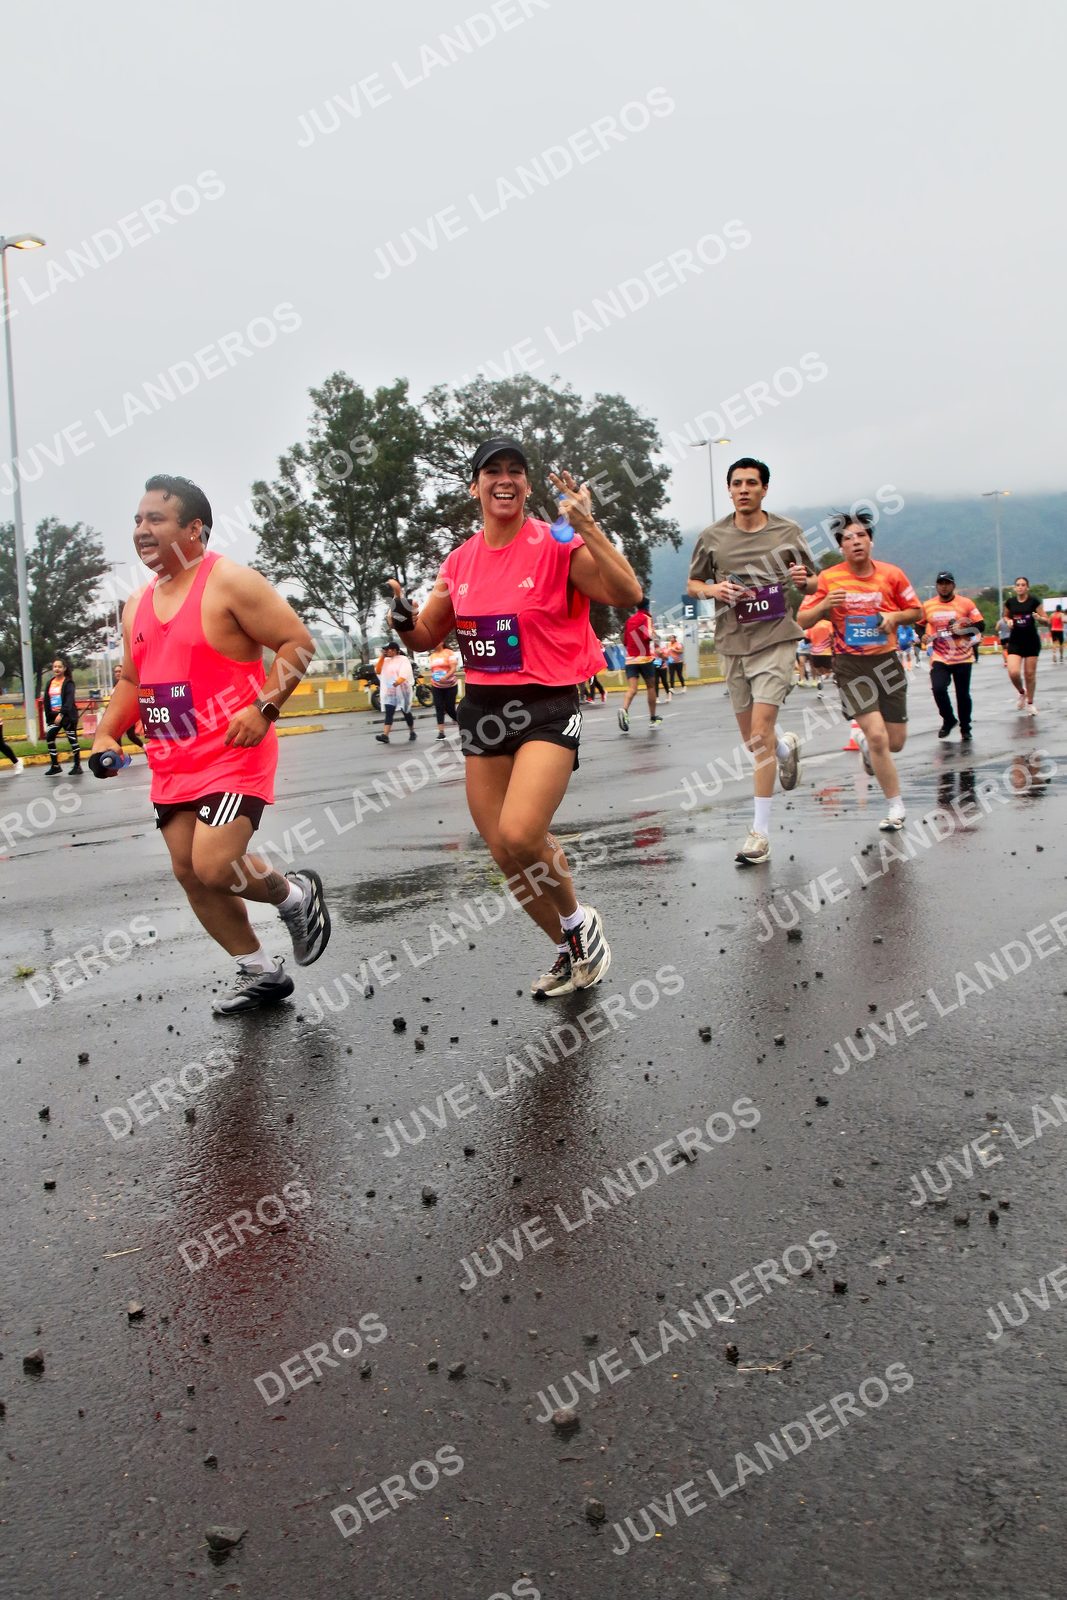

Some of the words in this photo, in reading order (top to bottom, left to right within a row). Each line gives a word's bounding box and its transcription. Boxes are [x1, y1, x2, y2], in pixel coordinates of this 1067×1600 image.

[685, 605, 694, 616] E
[746, 600, 769, 613] 710
[853, 628, 880, 638] 2568
[468, 640, 496, 656] 195
[147, 707, 170, 723] 298
